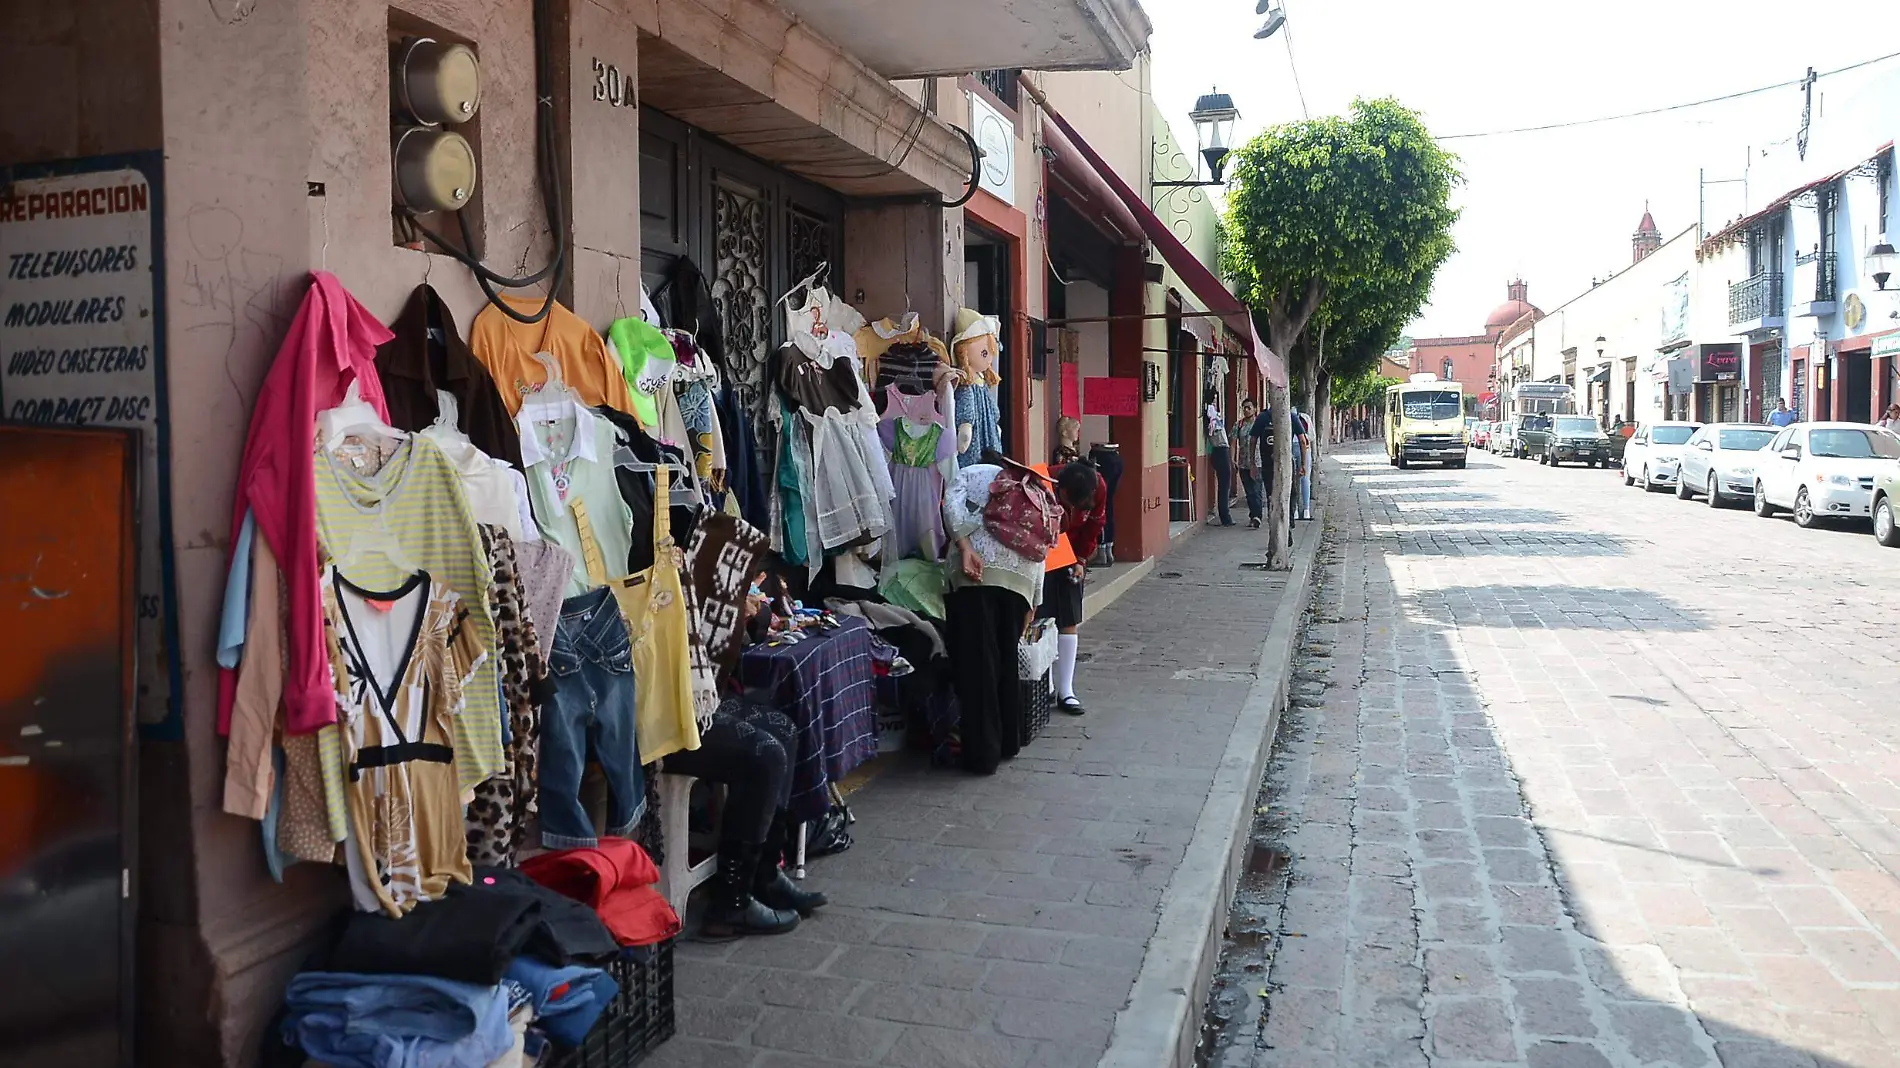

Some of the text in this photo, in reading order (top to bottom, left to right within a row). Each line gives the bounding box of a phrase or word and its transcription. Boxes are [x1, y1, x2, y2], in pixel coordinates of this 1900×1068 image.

[592, 56, 637, 109] 30A
[0, 184, 147, 223] REPARACION
[8, 245, 138, 280] TELEVISORES
[4, 296, 125, 328] MODULARES
[7, 345, 148, 377] VIDEO CASETERAS
[11, 396, 149, 424] COMPACT DISC
